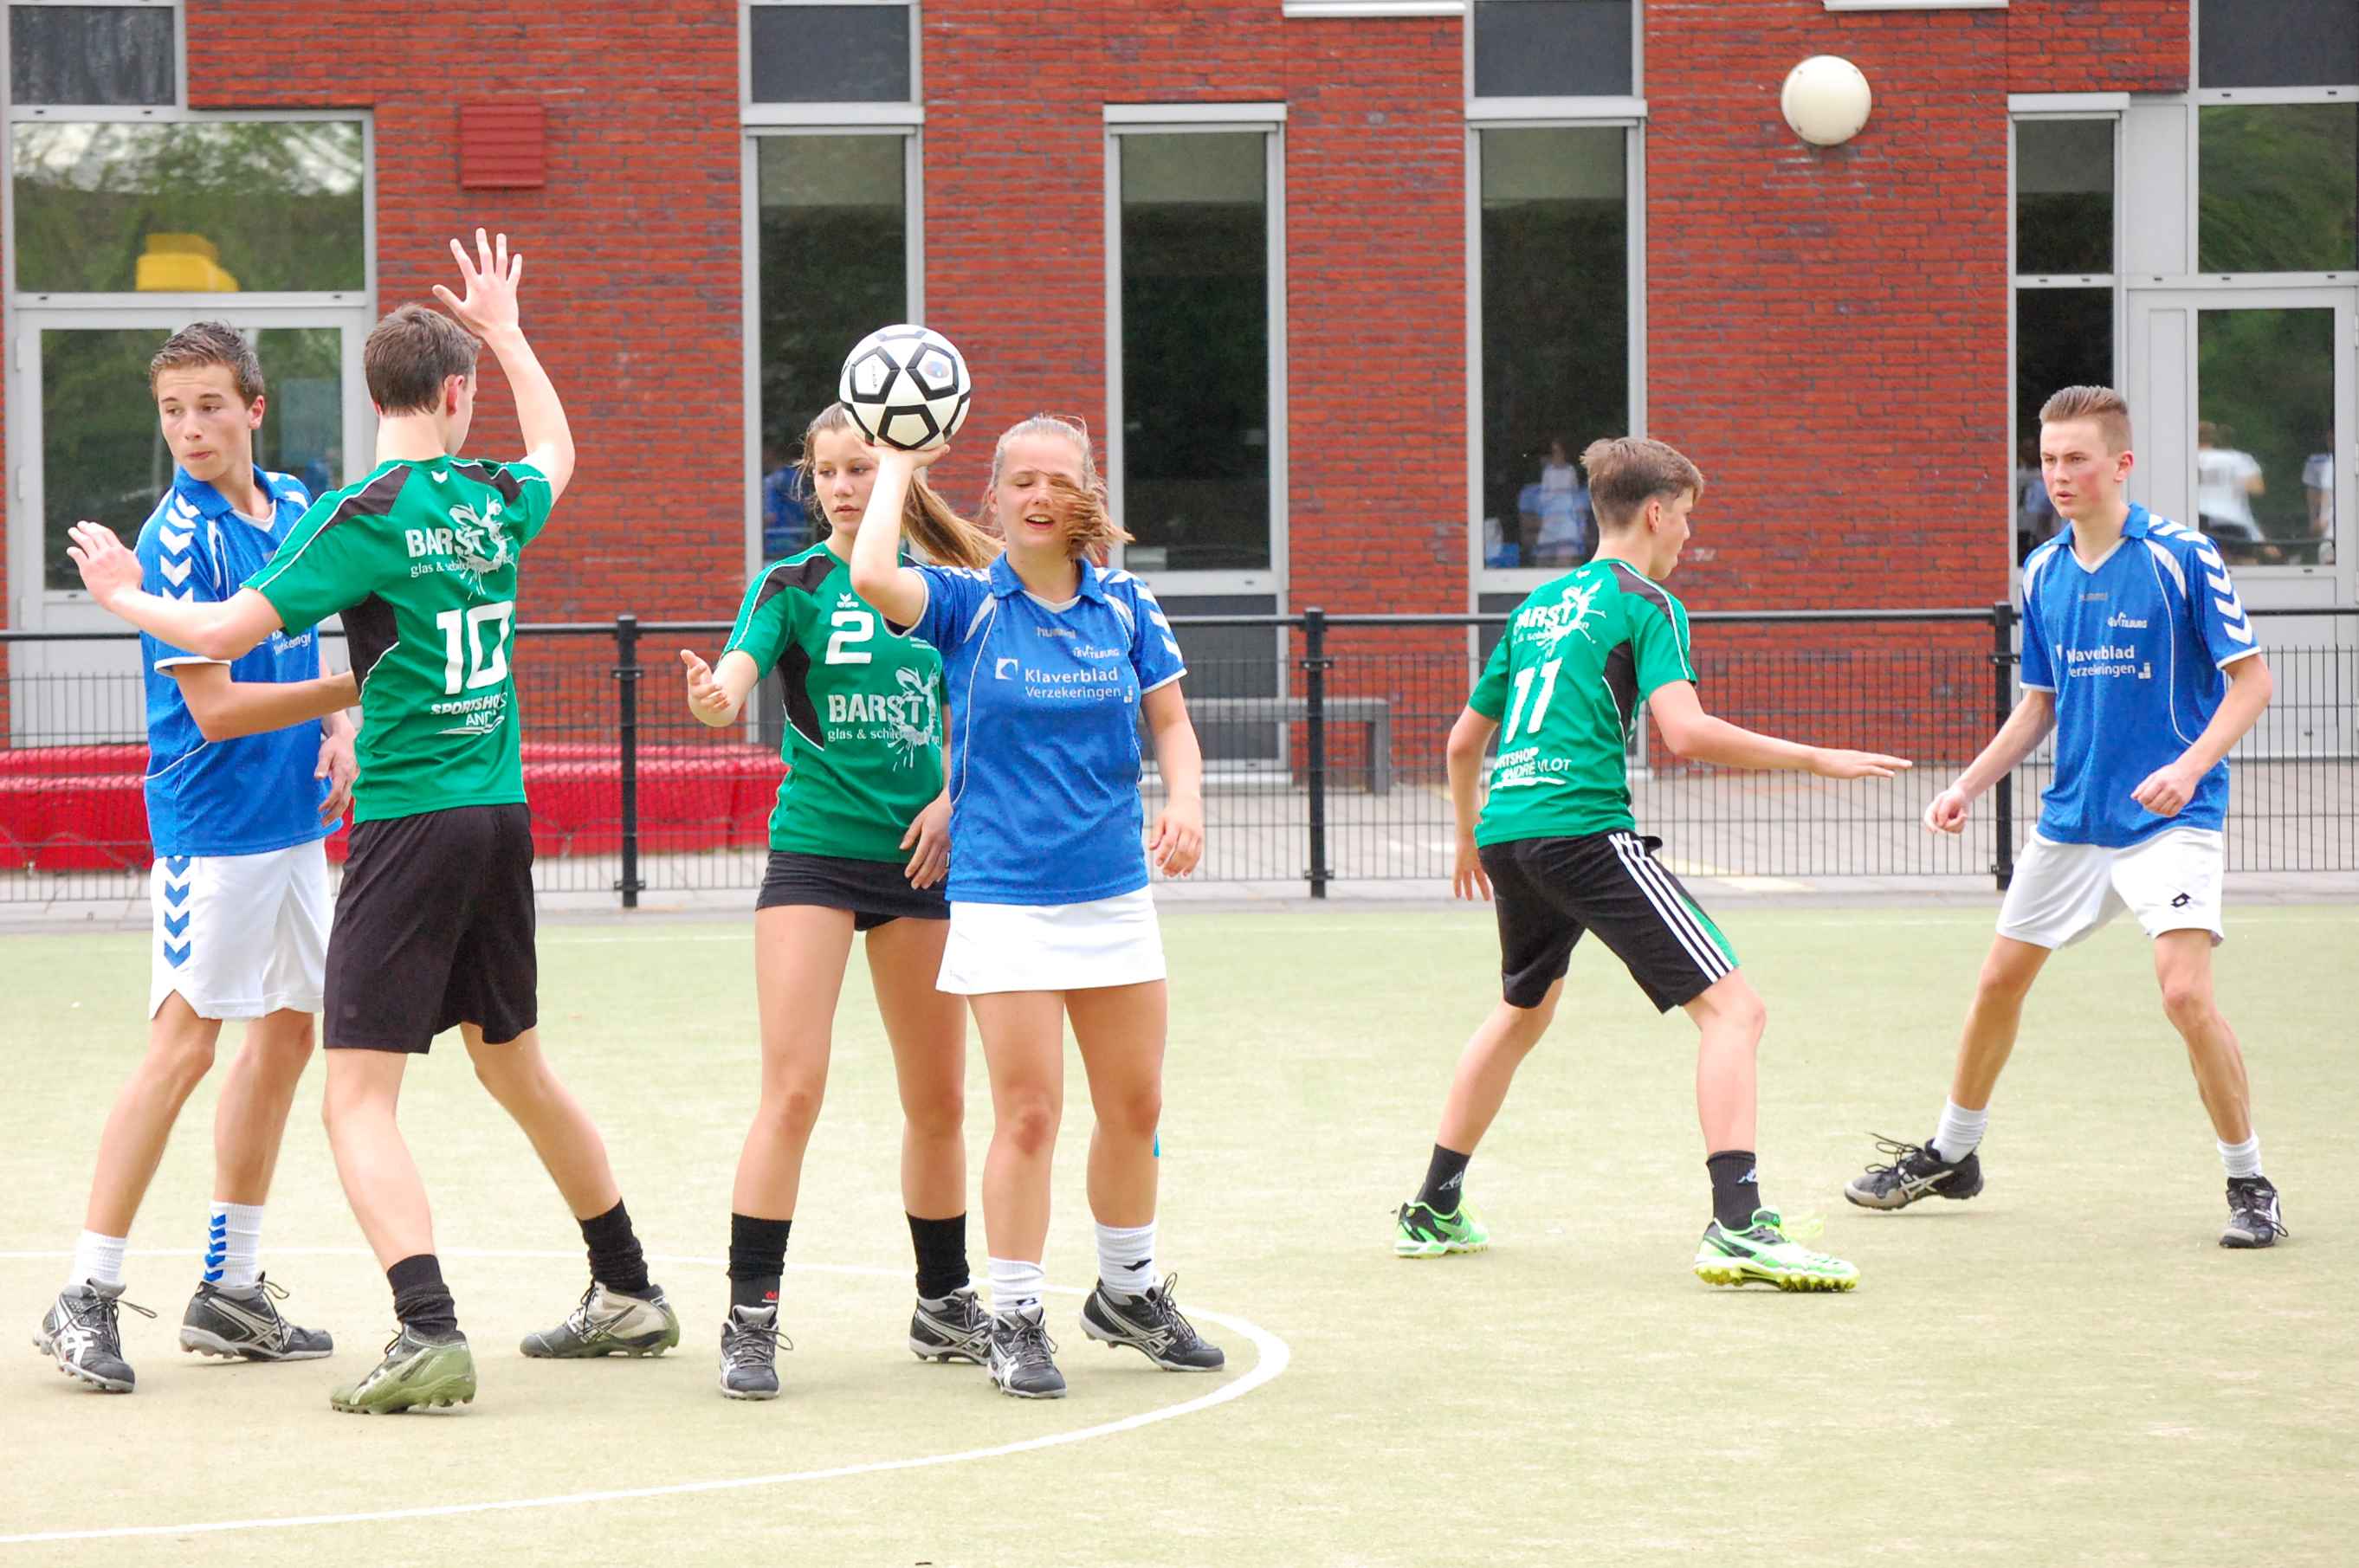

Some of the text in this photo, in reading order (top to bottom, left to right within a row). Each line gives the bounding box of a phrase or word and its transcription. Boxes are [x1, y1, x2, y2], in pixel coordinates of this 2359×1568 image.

[405, 527, 485, 558] BARST
[410, 562, 433, 578] glas
[436, 601, 514, 694] 10
[825, 610, 874, 664] 2
[1024, 667, 1119, 682] Klaverblad
[1024, 685, 1121, 700] Verzekeringen
[1505, 657, 1563, 745] 11
[828, 694, 925, 723] BARST
[828, 727, 853, 742] glas
[856, 728, 867, 739] &
